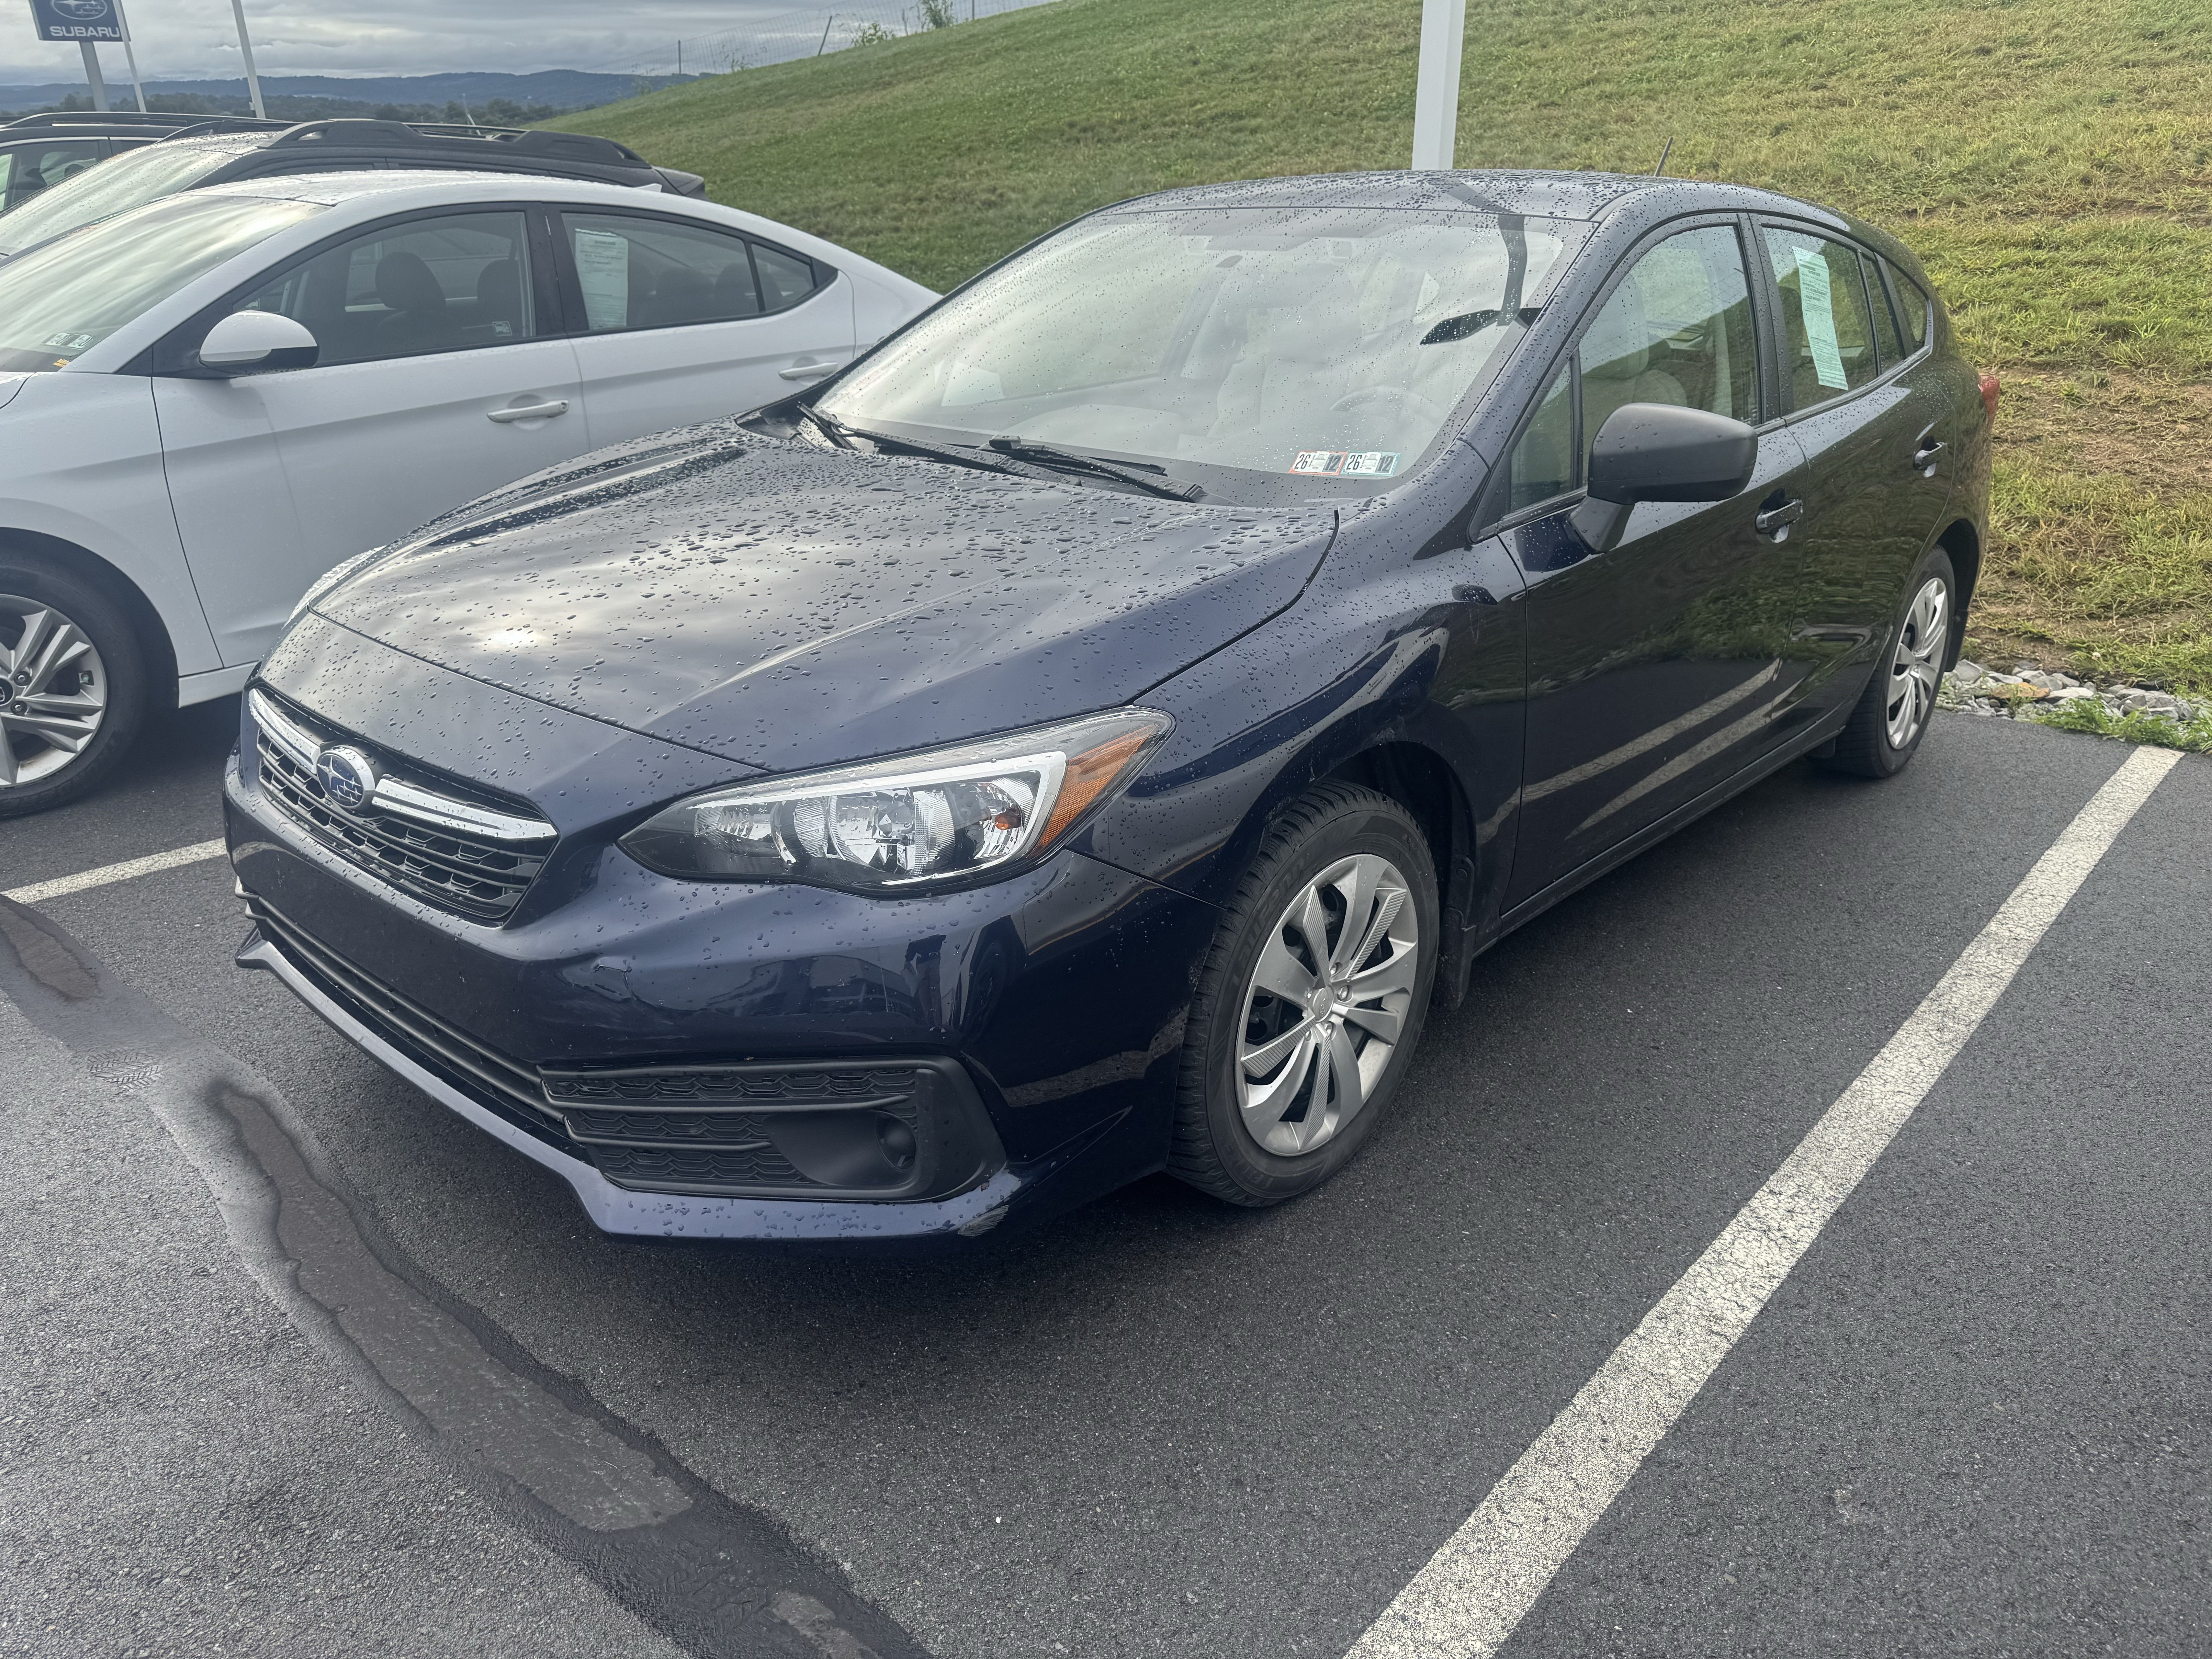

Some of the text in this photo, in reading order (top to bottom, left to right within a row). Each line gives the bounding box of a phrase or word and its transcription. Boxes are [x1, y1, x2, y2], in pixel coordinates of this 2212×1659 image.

[50, 26, 120, 37] SUBARU
[1294, 454, 1311, 469] 26
[1325, 455, 1342, 471] 12
[1346, 454, 1362, 470] 26
[1377, 455, 1394, 472] 12
